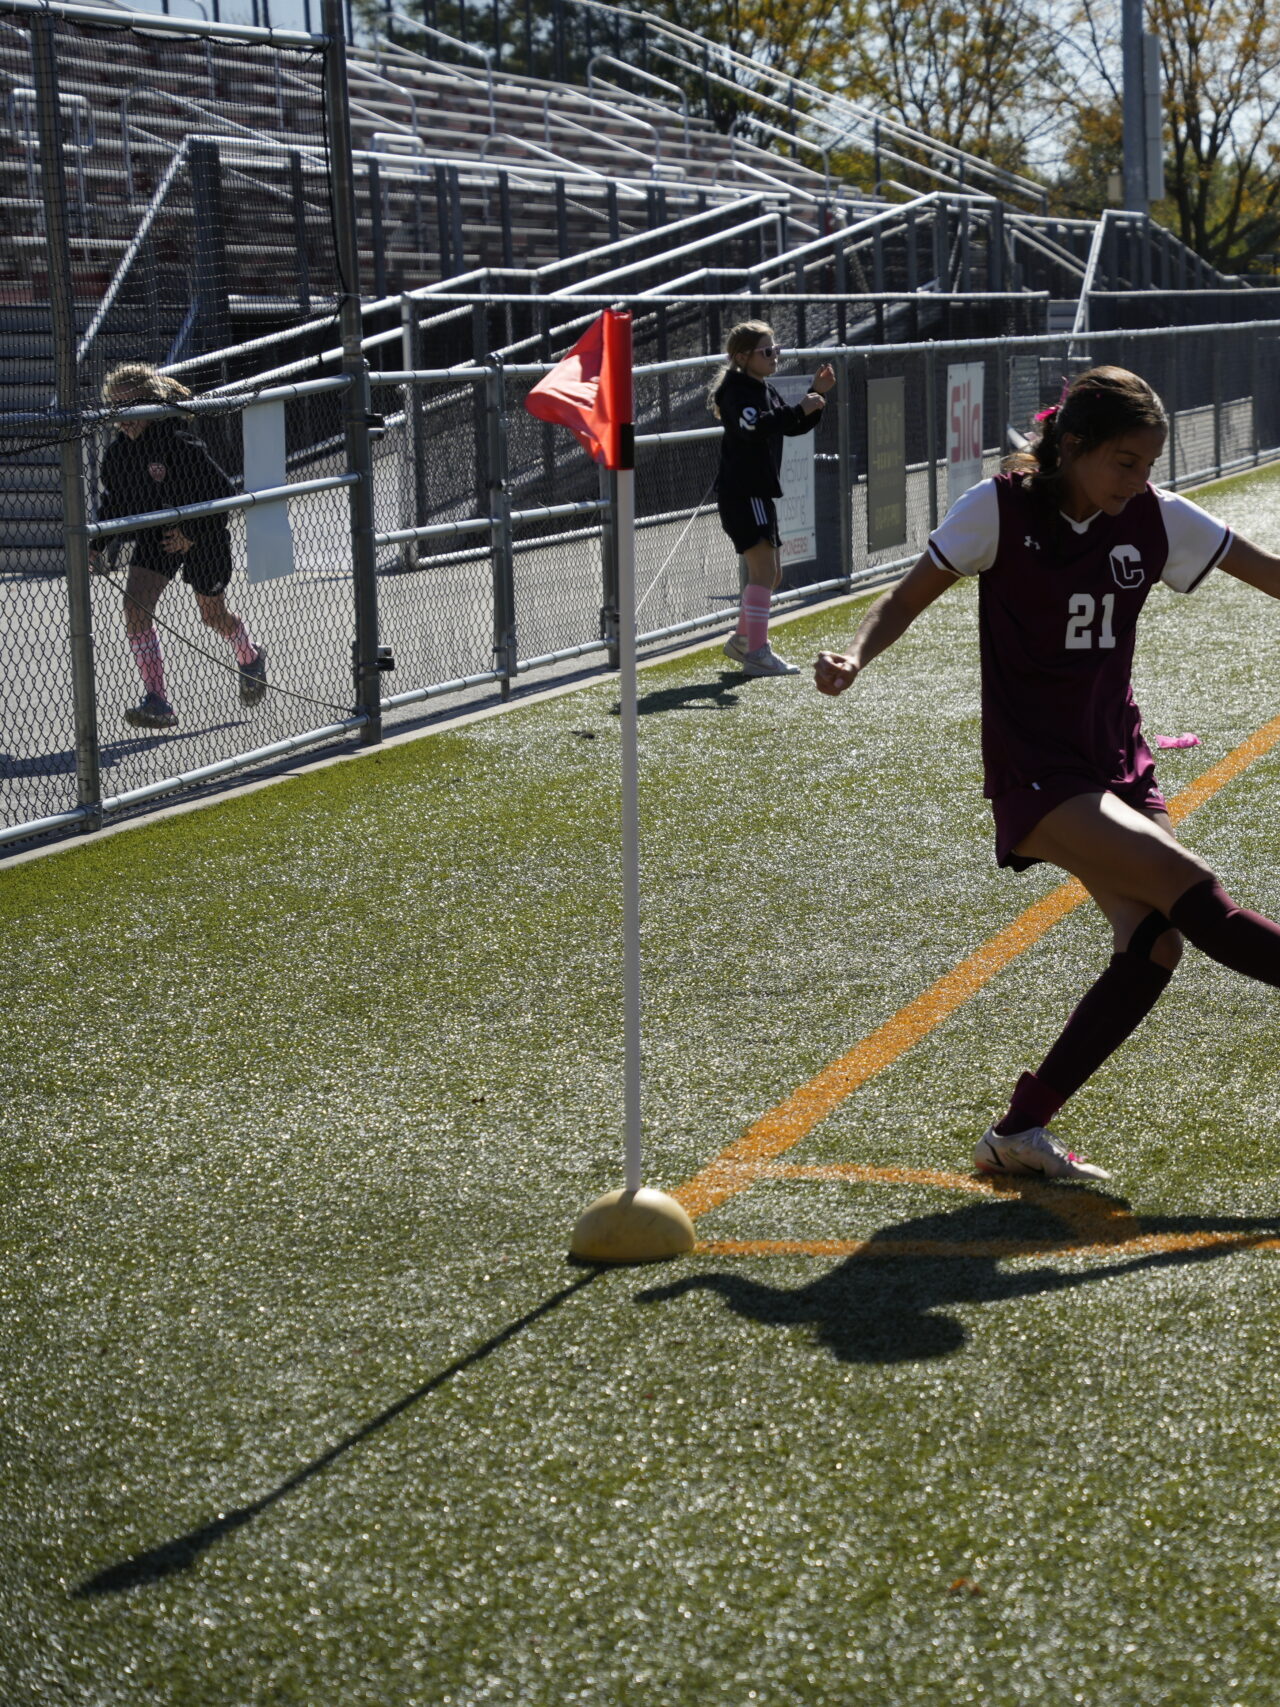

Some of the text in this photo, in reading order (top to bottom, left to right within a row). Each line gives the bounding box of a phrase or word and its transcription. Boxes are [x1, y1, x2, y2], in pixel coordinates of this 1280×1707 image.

[951, 379, 980, 463] Sila
[1108, 544, 1146, 589] C
[1065, 592, 1117, 649] 21
